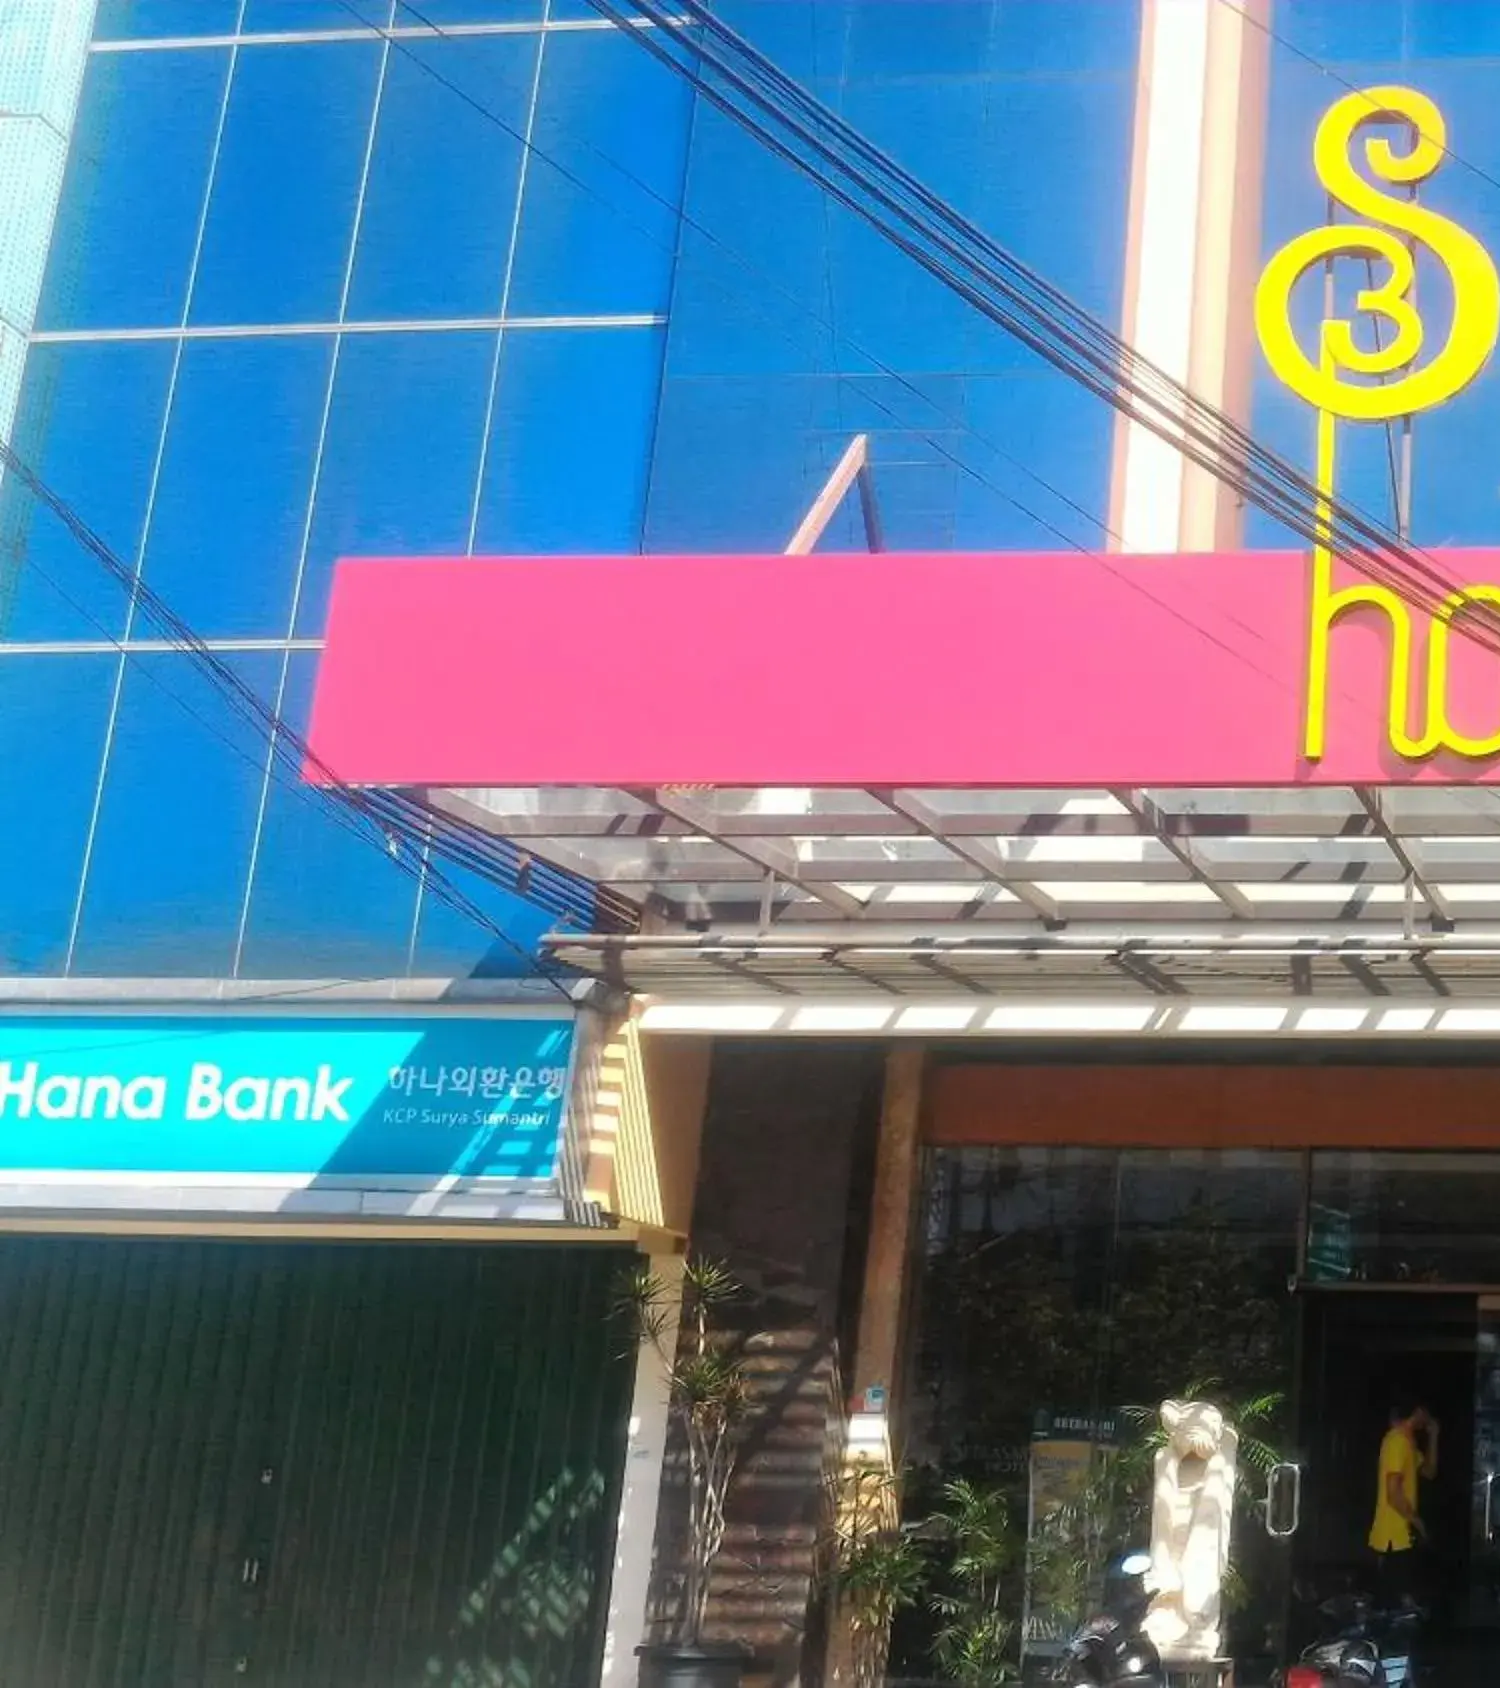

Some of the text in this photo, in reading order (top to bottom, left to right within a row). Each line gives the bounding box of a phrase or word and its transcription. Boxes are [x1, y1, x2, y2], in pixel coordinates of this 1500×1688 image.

[0, 1060, 354, 1121] Hana Bank
[388, 1065, 566, 1099] 하나외환은행
[383, 1109, 551, 1128] KCP Surya Sumantri
